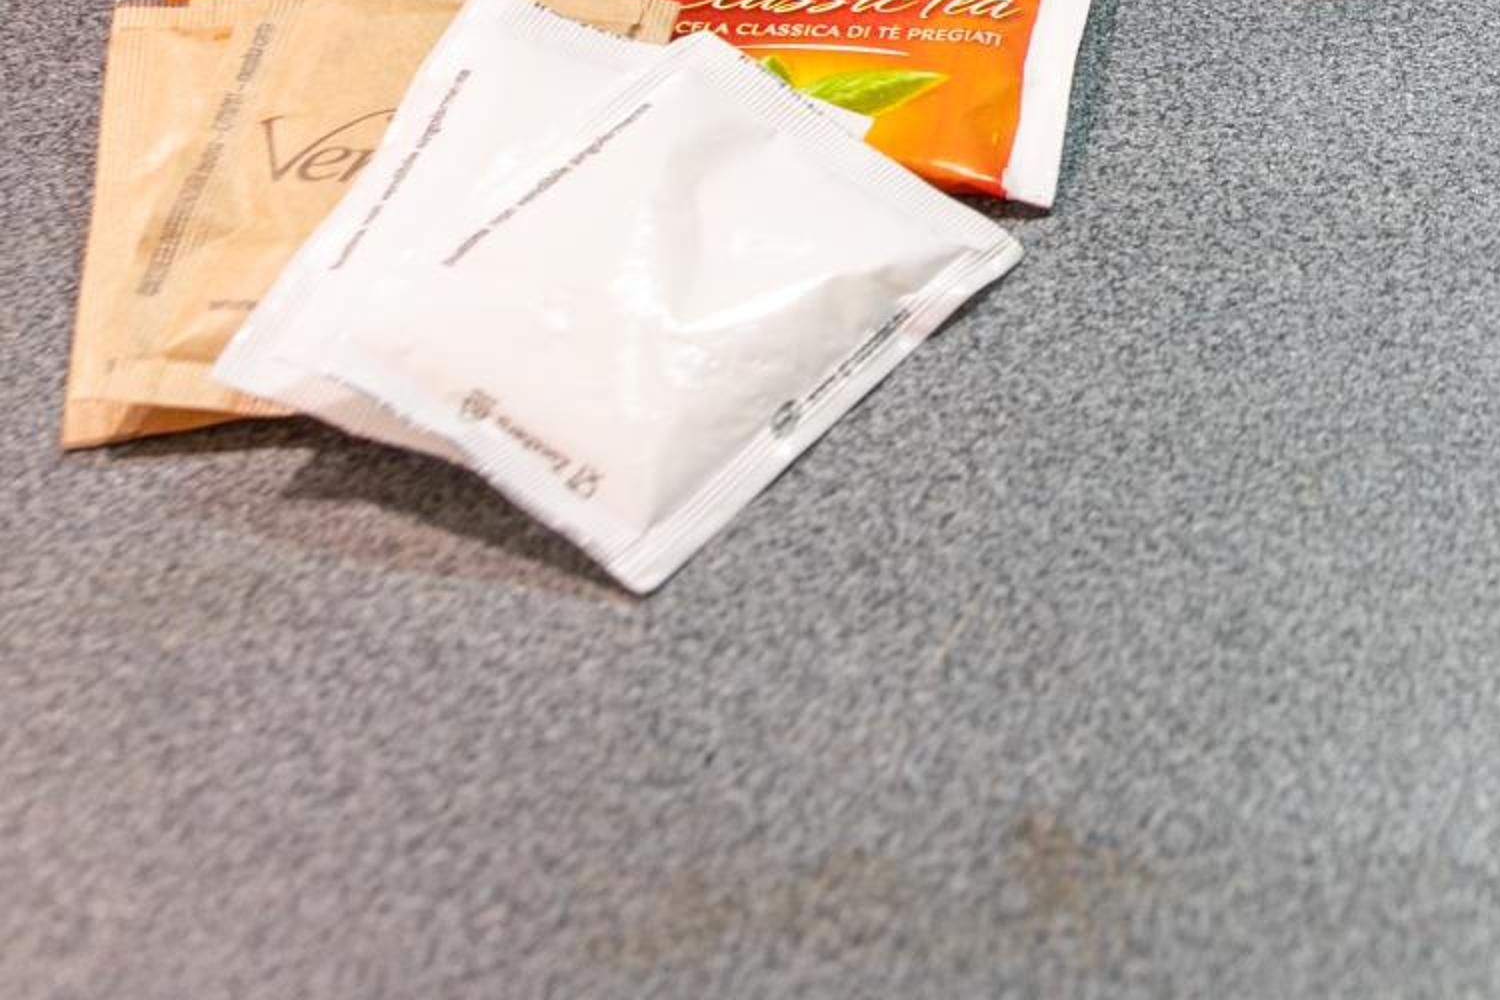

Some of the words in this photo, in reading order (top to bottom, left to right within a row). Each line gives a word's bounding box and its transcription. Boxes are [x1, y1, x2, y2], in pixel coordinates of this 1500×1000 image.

[736, 22, 840, 38] CLASSICA
[847, 25, 870, 38] DI
[908, 26, 1001, 47] PREGIATI
